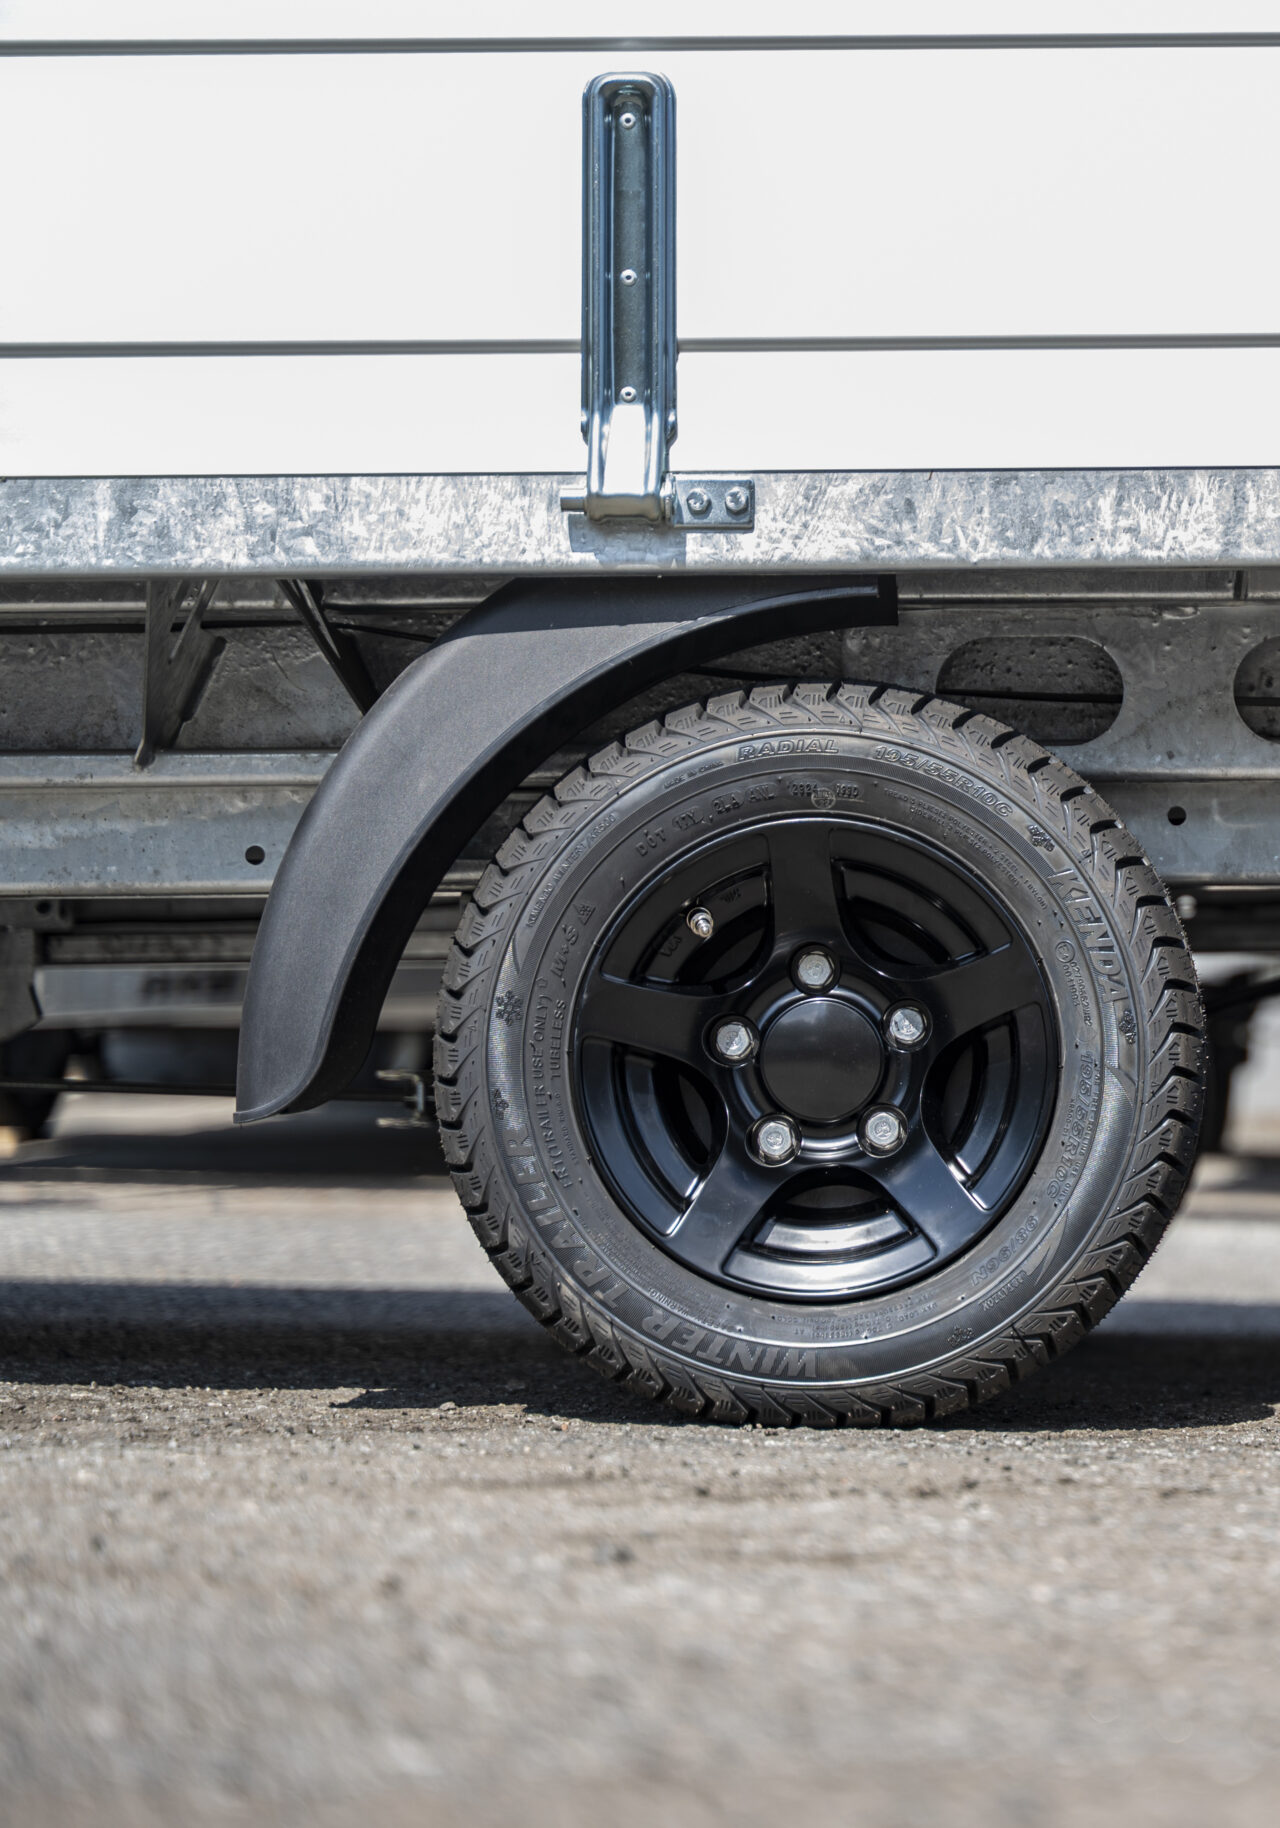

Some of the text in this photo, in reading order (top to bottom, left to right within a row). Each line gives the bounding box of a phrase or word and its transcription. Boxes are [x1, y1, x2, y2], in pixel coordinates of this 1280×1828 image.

[733, 736, 840, 764] RADIAL
[872, 744, 1016, 821] 195/55R10C
[633, 825, 669, 858] DOT
[547, 923, 582, 979] M+S
[1045, 861, 1129, 1004] KENDA
[531, 1046, 544, 1079] USE
[549, 998, 567, 1080] TUBELESS
[1042, 1053, 1094, 1200] 195/55R10C
[498, 1120, 631, 1310] TRAILER
[966, 1213, 1042, 1287] 98/96N
[637, 1303, 816, 1378] WINTER
